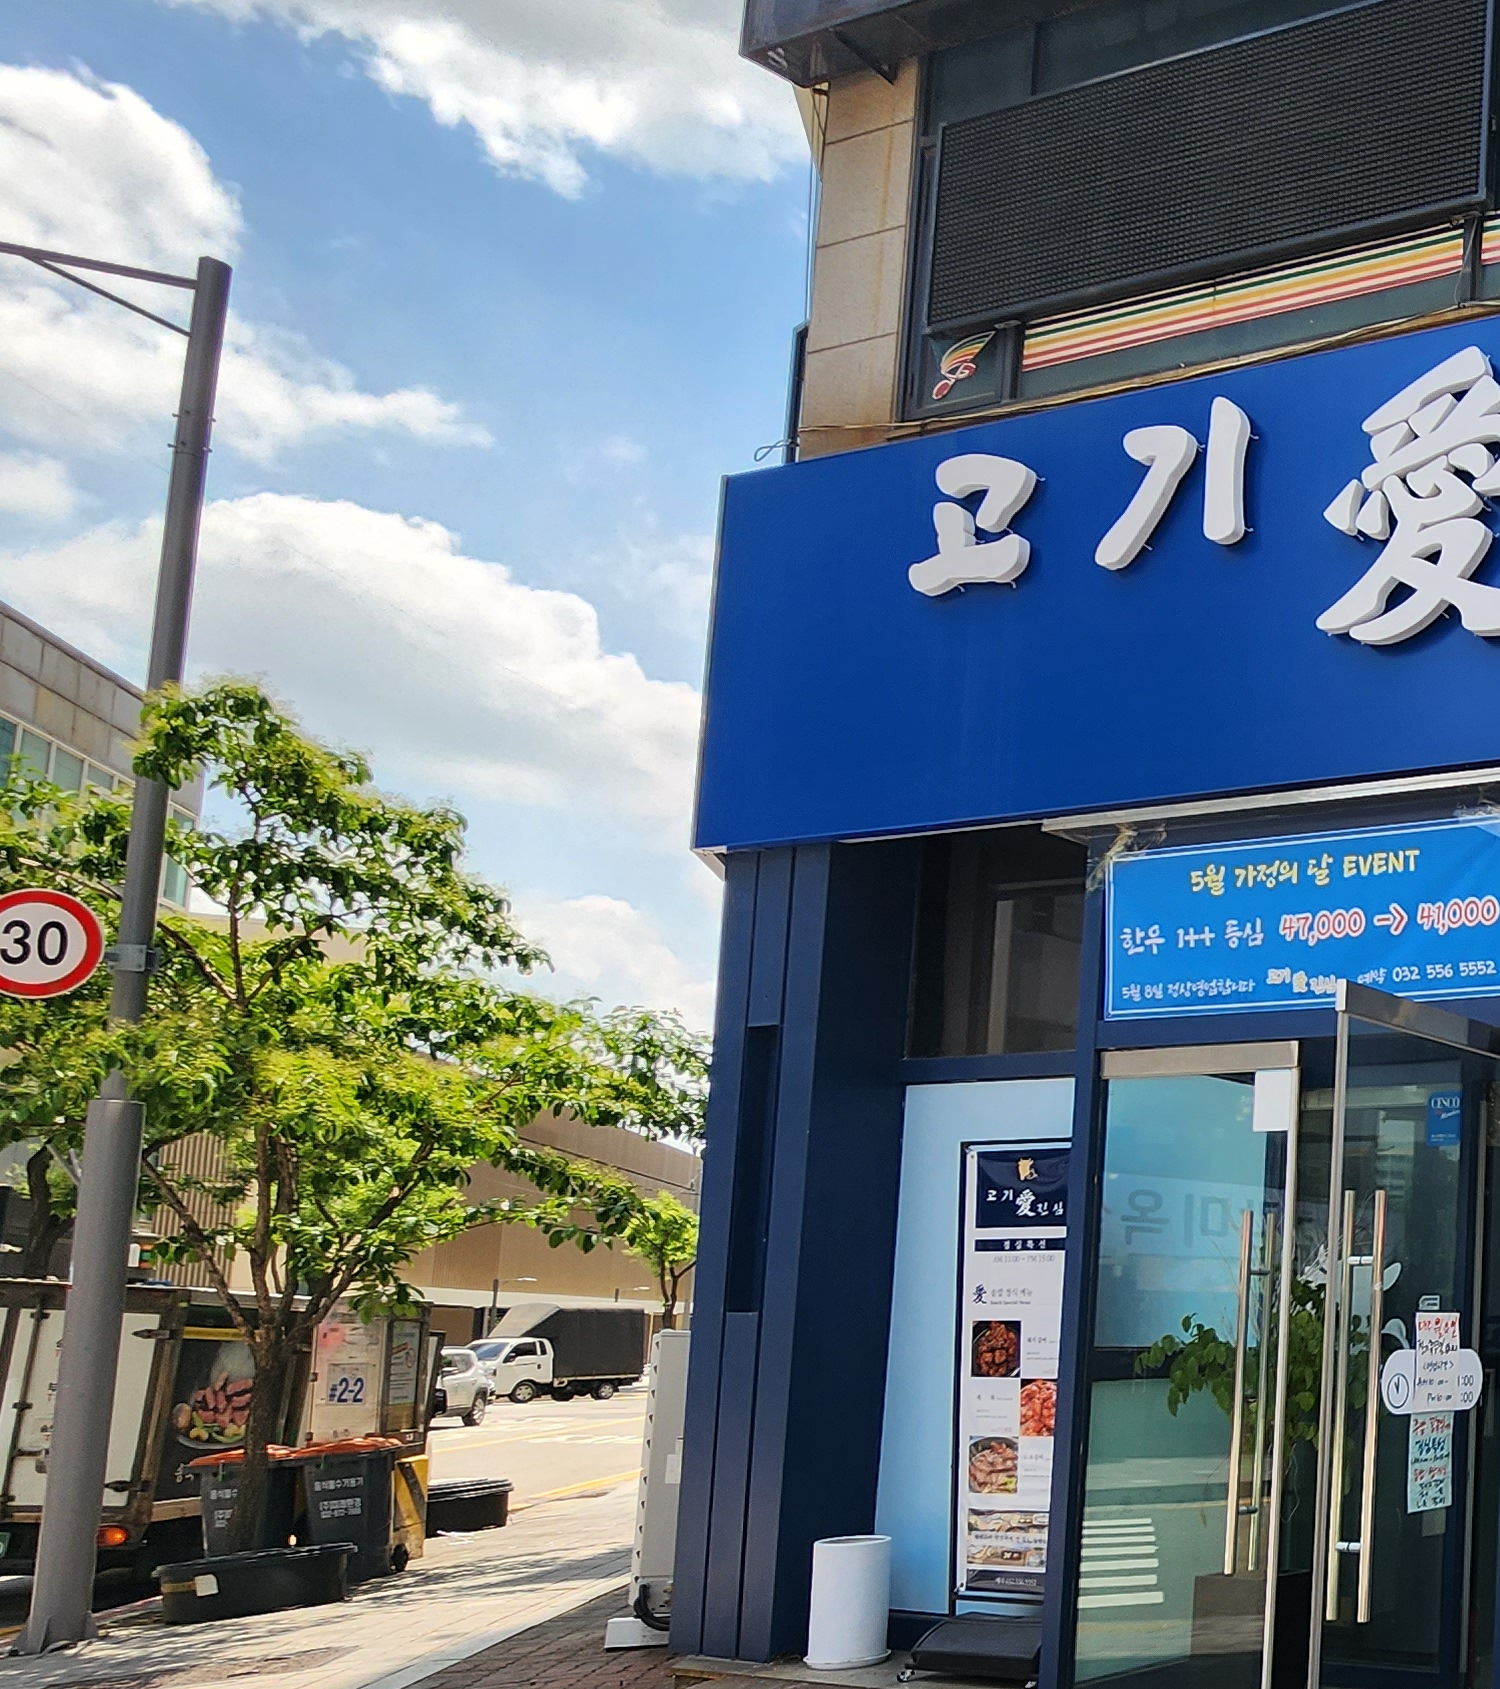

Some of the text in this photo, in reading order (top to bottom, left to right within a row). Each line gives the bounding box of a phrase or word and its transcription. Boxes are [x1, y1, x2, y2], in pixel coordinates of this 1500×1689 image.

[1190, 849, 1420, 896] 5월 가정의 달 EVENT
[0, 919, 68, 966] 30
[1120, 924, 1166, 956] 한우
[1224, 918, 1264, 949] 등심
[1279, 908, 1366, 946] 47,000
[1416, 895, 1500, 934] 41,000
[1144, 981, 1164, 999] 8일
[1392, 964, 1421, 982] 032
[1426, 962, 1454, 979] 556
[1459, 960, 1498, 977] 5552
[328, 1377, 364, 1403] #2-2
